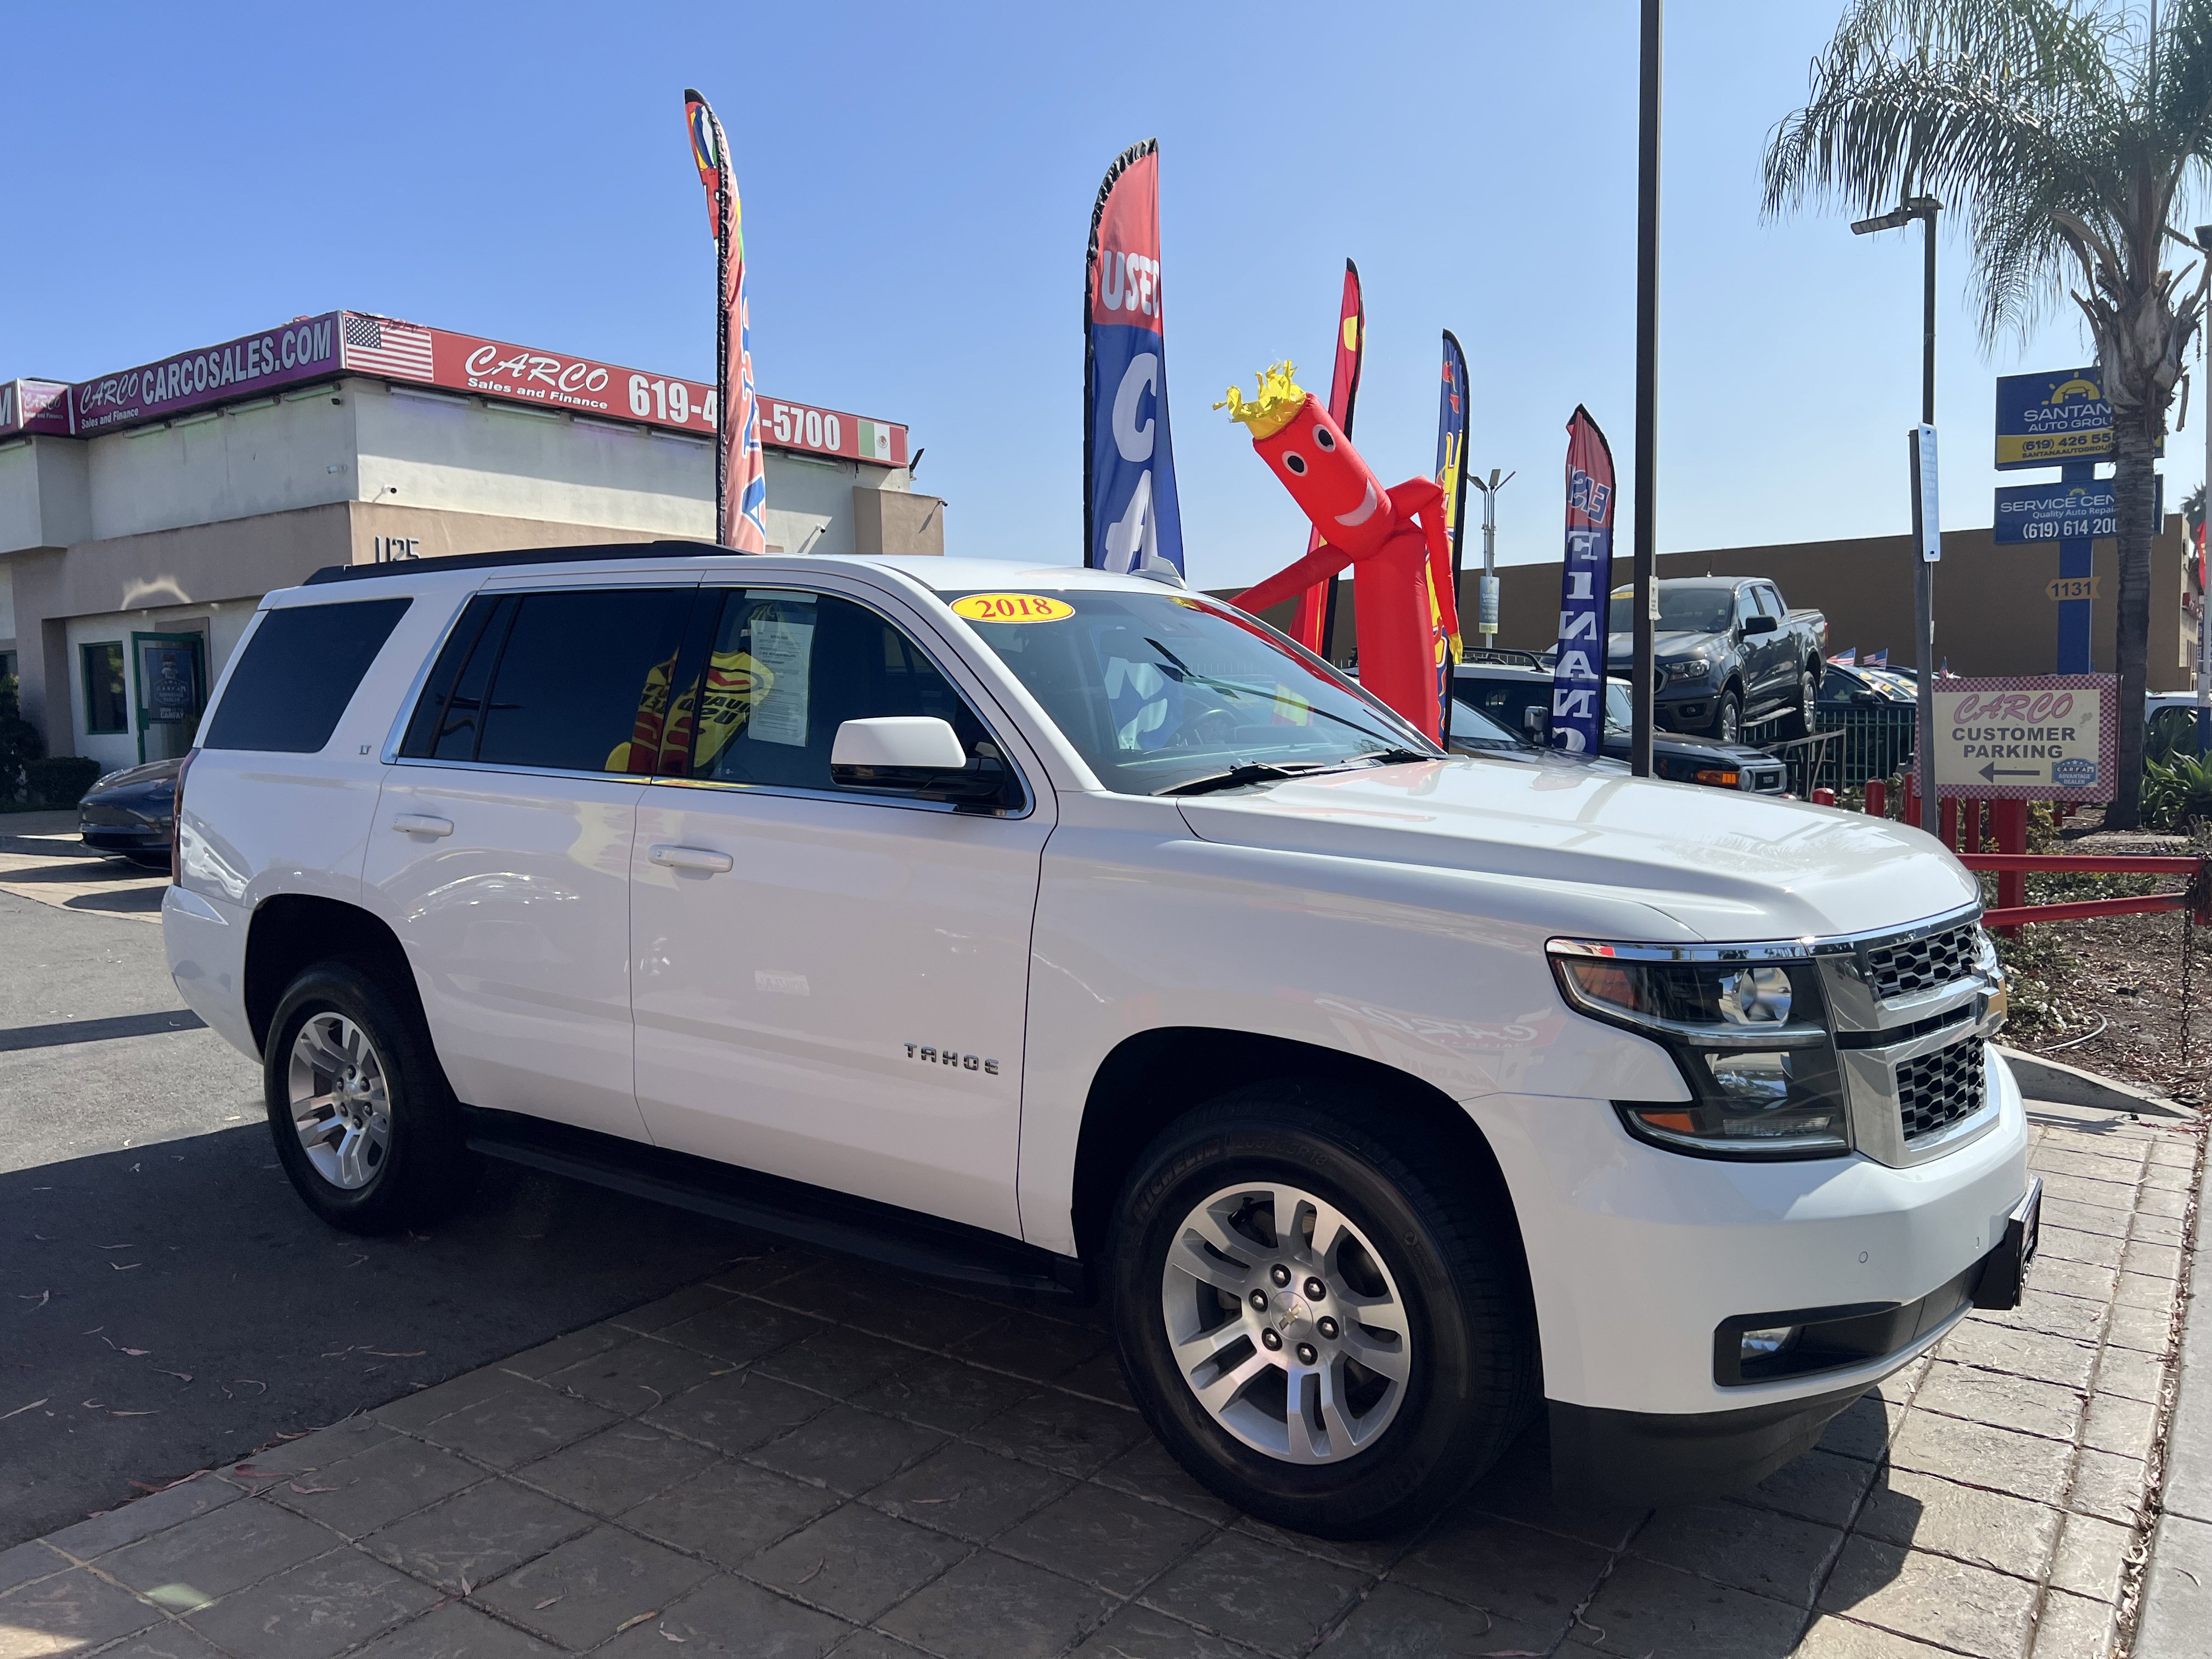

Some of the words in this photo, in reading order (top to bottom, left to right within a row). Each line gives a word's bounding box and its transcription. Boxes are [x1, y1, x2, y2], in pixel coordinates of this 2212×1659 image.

[142, 319, 332, 405] CARCOSALES.COM
[465, 345, 609, 392] CARCO
[24, 392, 61, 410] CARCO
[80, 372, 139, 414] CARCO
[467, 376, 512, 393] Sales
[516, 387, 546, 398] and
[550, 391, 608, 409] Finance
[82, 418, 98, 430] Sales
[99, 414, 111, 424] and
[113, 408, 139, 421] Finance
[628, 374, 841, 451] 619-4-5700
[2024, 403, 2112, 422] SANTAN
[2029, 421, 2068, 432] AUTO
[2071, 417, 2113, 428] GROU
[2023, 438, 2055, 452] (619)
[2058, 435, 2087, 447] 426
[2091, 432, 2115, 444] 55
[2000, 497, 2077, 512] SERVICE
[2080, 495, 2115, 507] CEN
[2033, 510, 2064, 520] Quality
[2066, 508, 2087, 516] Auto
[2023, 521, 2059, 539] (619)
[2063, 520, 2089, 536] 614
[2092, 518, 2117, 534] 20
[2051, 582, 2092, 597] 1131
[975, 599, 1052, 618] 2018
[1953, 692, 2074, 724] CARCO
[1952, 727, 2076, 742] CUSTOMER
[358, 744, 372, 755] LT
[1963, 744, 2063, 759] PARKING
[904, 1042, 999, 1075] TAHOE
